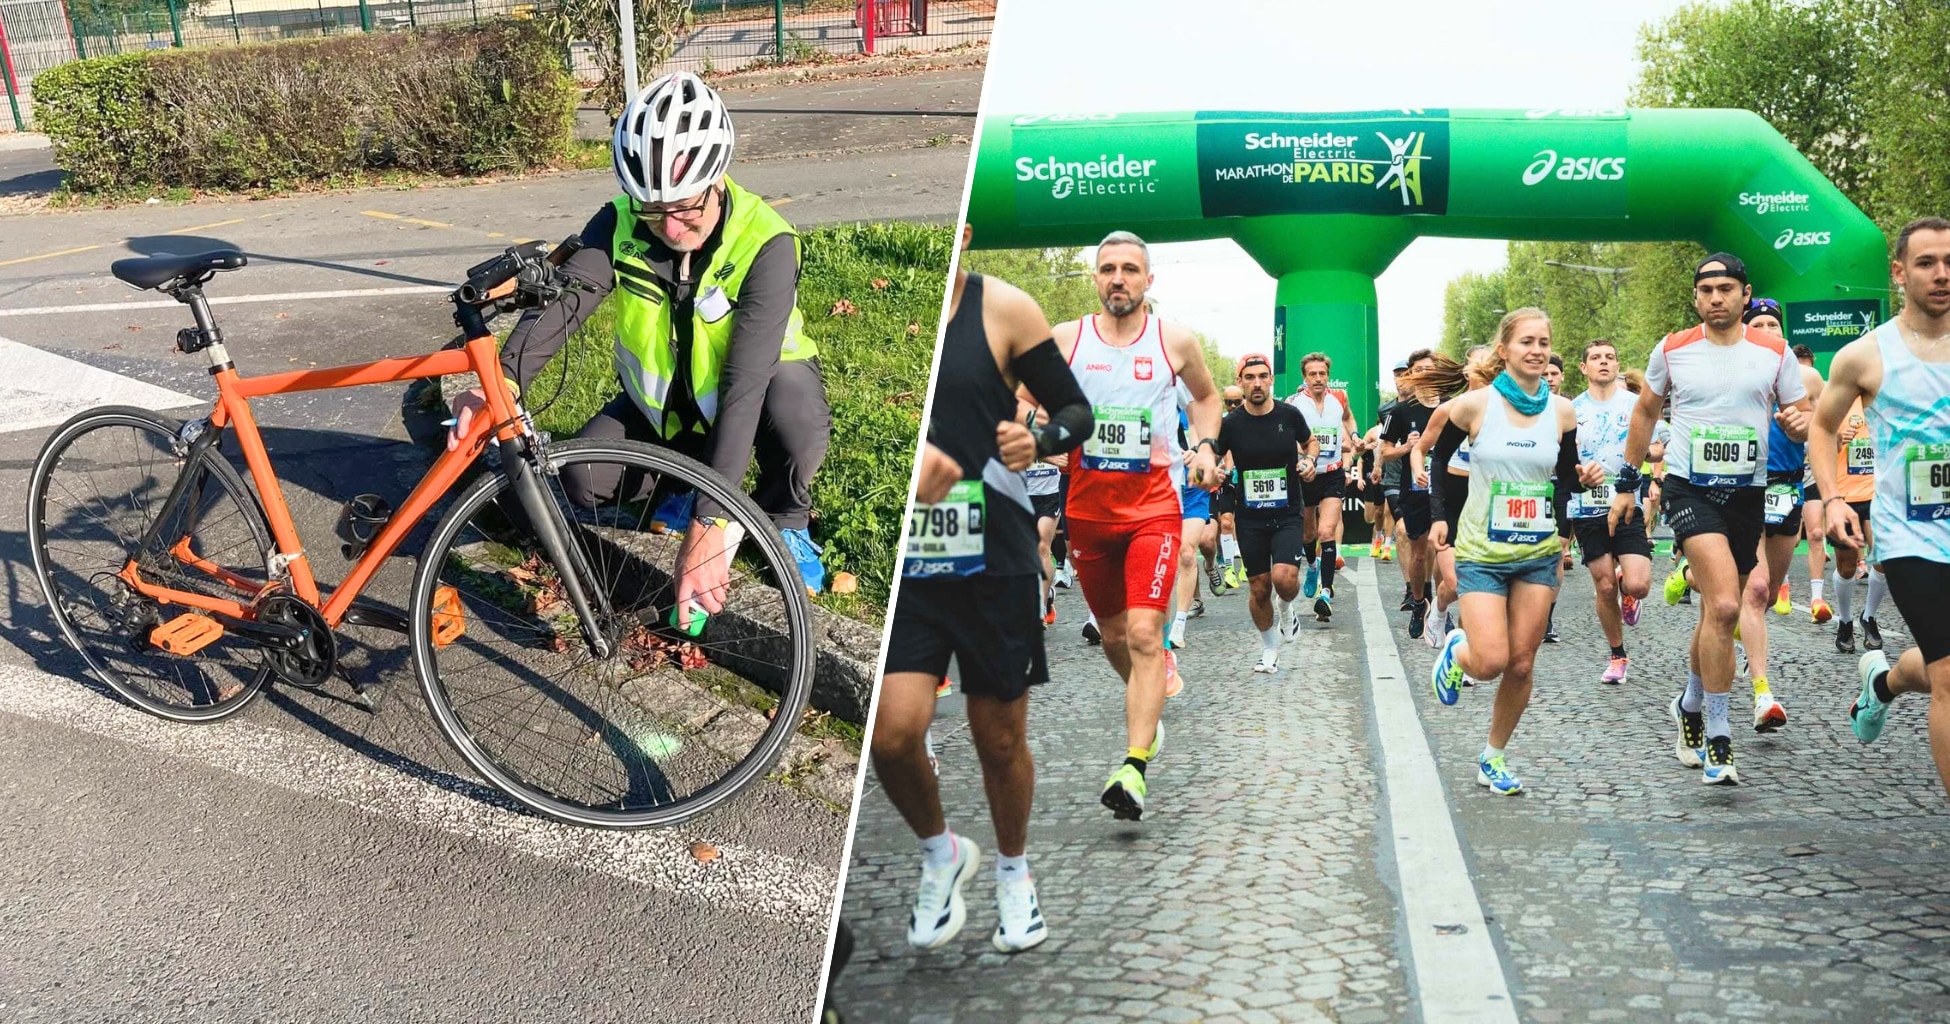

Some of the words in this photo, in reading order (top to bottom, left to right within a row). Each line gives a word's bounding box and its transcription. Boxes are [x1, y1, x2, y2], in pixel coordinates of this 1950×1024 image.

[1245, 132, 1358, 150] Schneider
[1294, 148, 1356, 159] Electric
[1015, 154, 1157, 181] Schneider
[1215, 162, 1294, 181] MARATHON
[1294, 162, 1375, 184] PARIS
[1282, 174, 1294, 183] DE
[1739, 190, 1809, 205] Schneider
[1770, 204, 1810, 212] Electric
[1804, 311, 1853, 322] Schneider
[1793, 327, 1826, 335] MARATHON
[1827, 326, 1860, 335] PARIS
[1326, 379, 1349, 388] eider
[1098, 423, 1126, 445] 498
[1703, 442, 1740, 462] 6909
[1253, 480, 1275, 493] 5618
[1507, 498, 1537, 519] 1810
[1148, 532, 1173, 599] POLSKA
